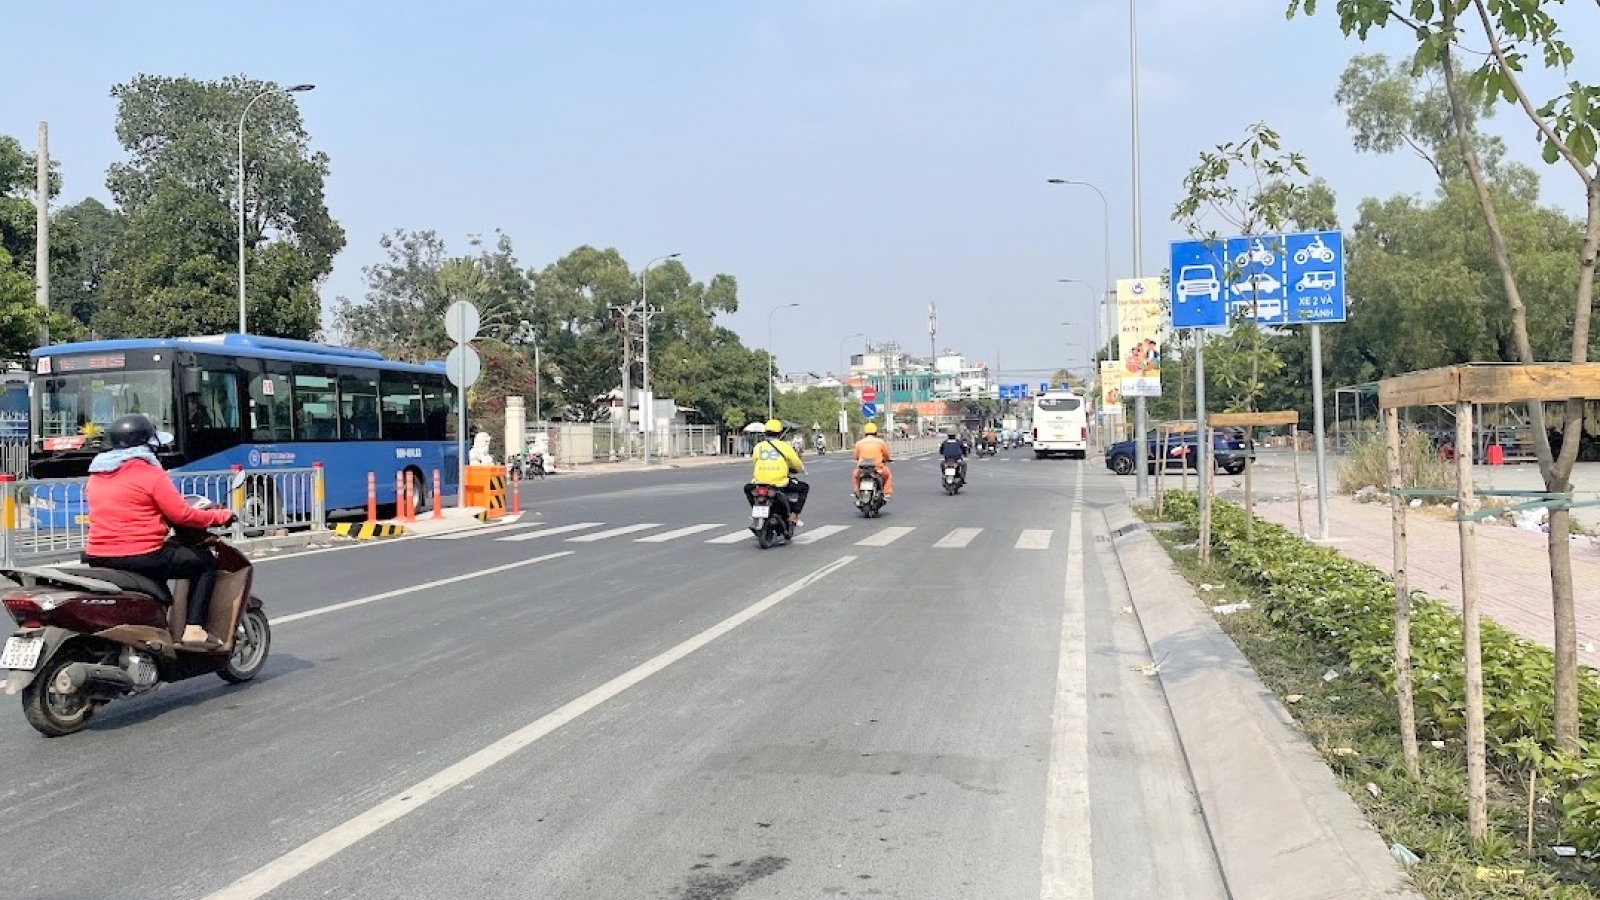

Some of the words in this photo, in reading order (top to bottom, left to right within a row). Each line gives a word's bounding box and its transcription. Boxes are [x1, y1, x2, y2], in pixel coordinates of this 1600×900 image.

[1299, 297, 1311, 306] XE
[1312, 296, 1319, 306] 2
[1320, 294, 1333, 304] VÀ
[759, 446, 778, 460] be
